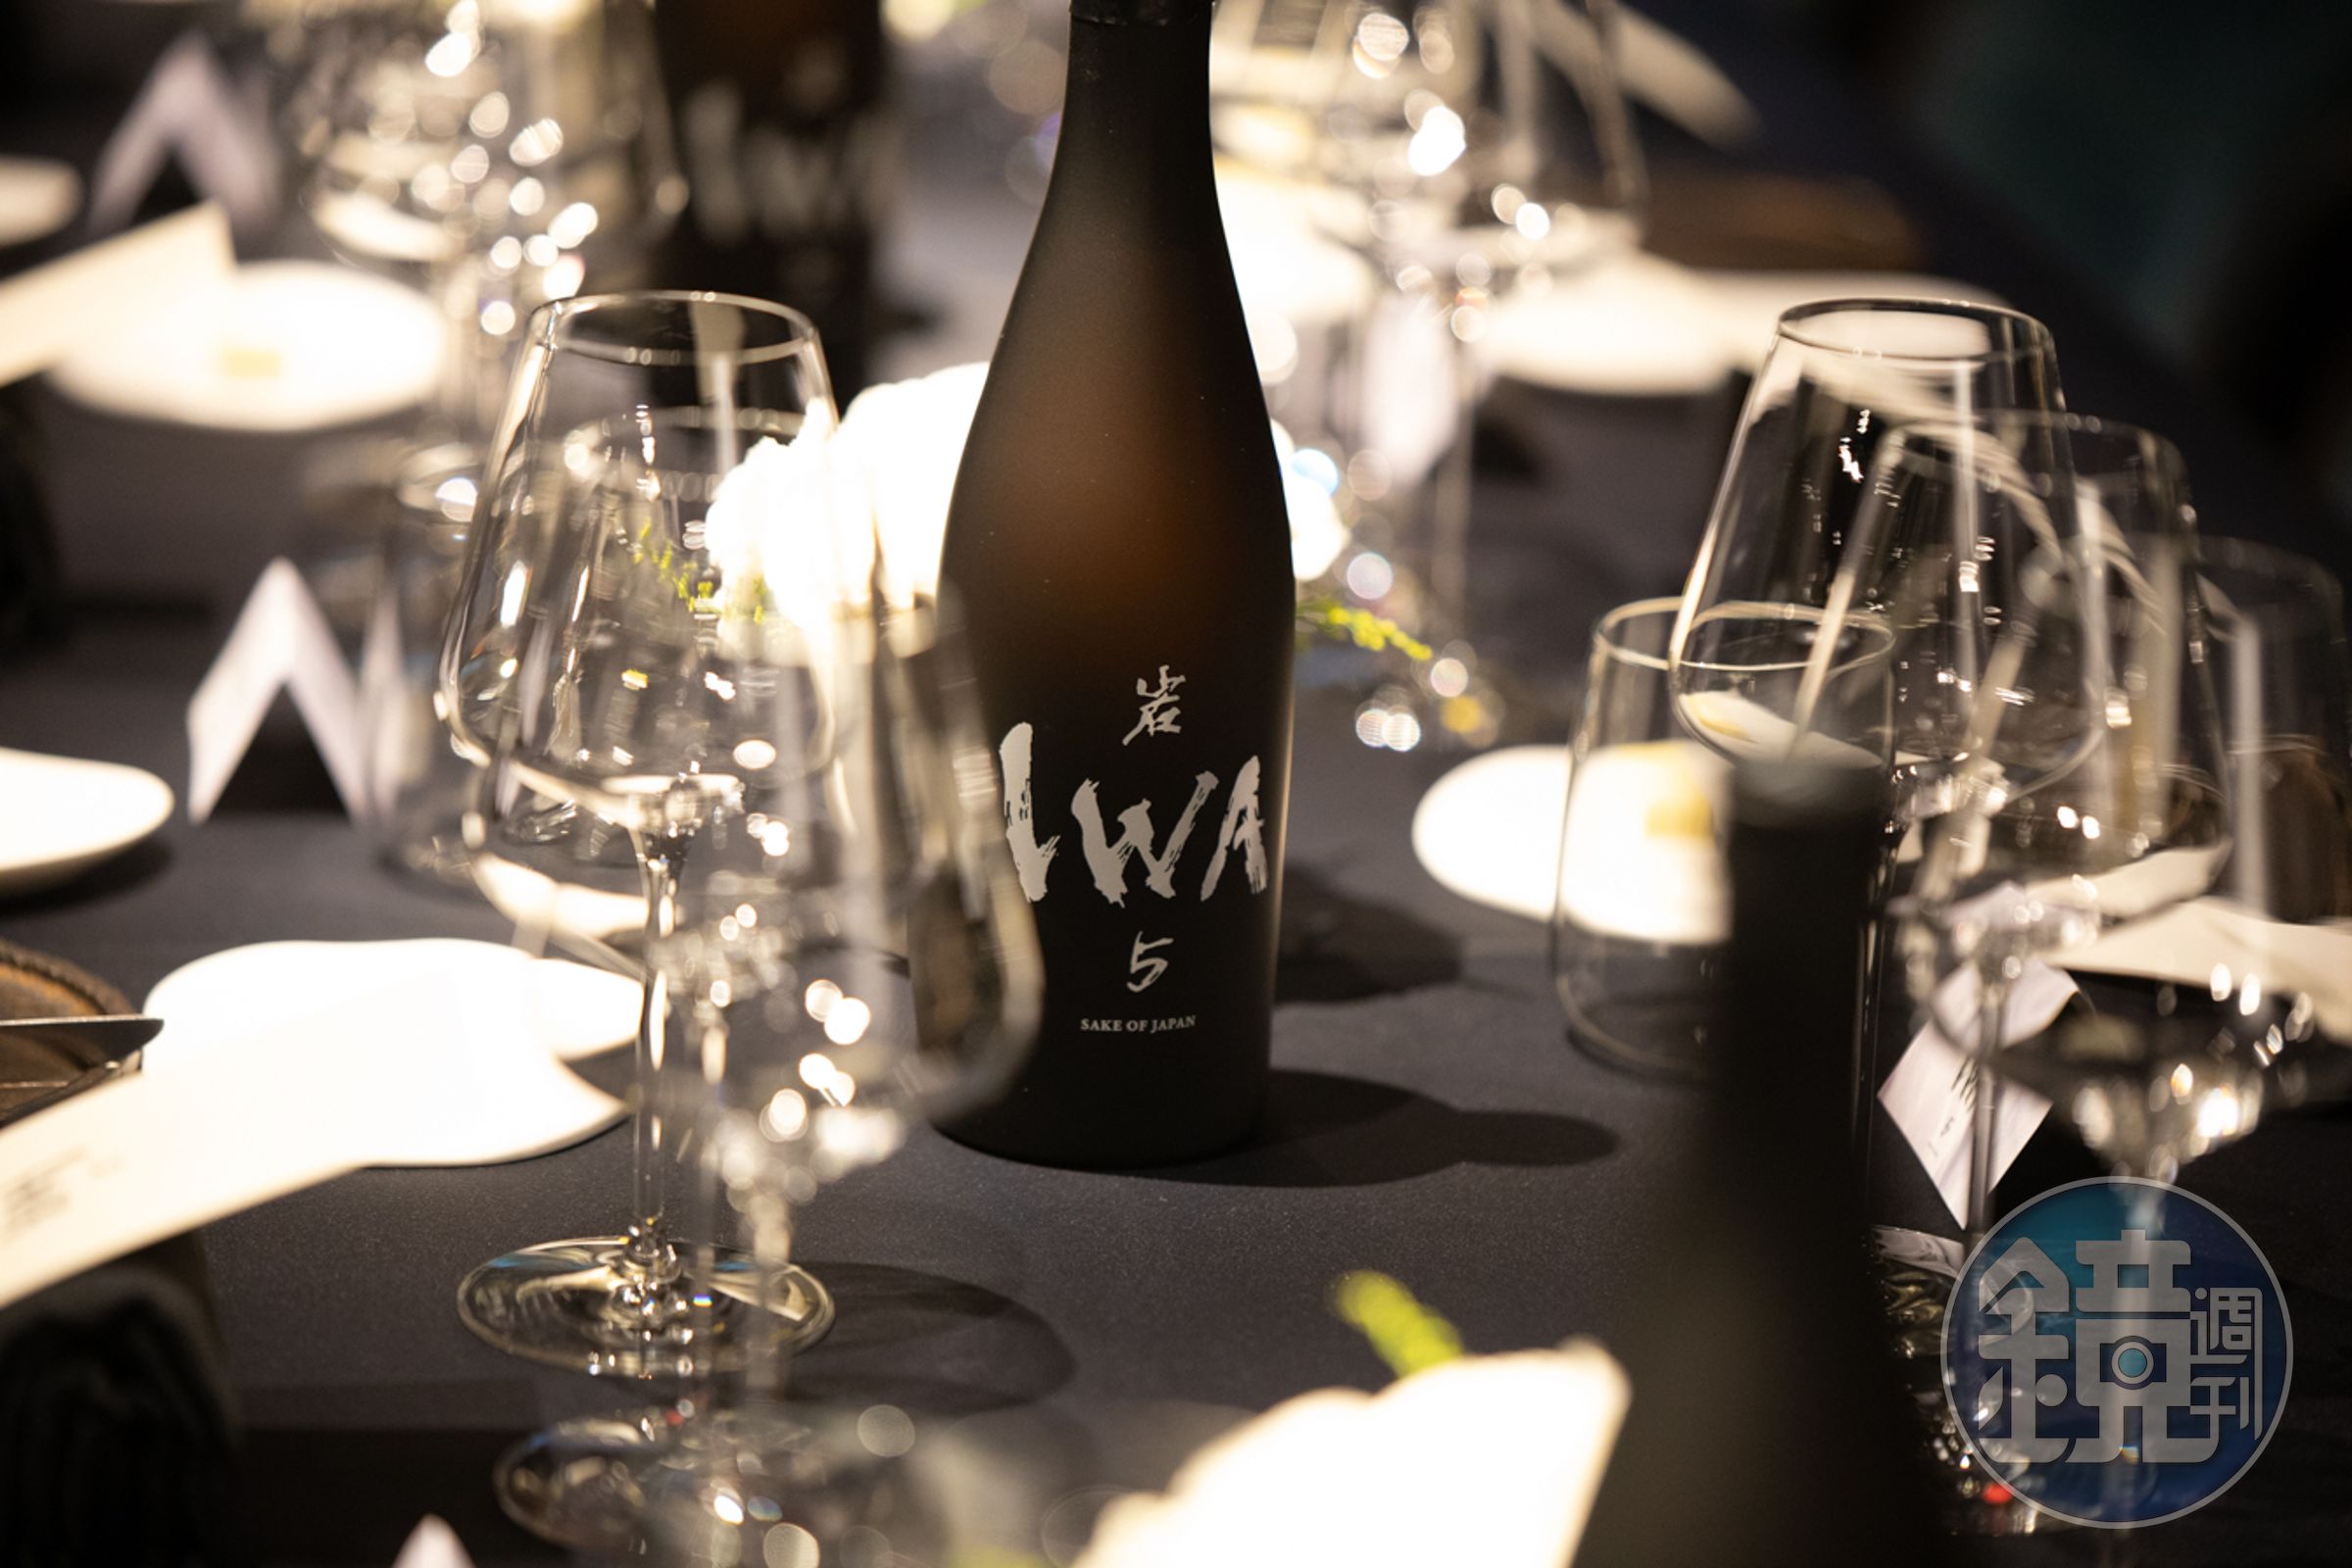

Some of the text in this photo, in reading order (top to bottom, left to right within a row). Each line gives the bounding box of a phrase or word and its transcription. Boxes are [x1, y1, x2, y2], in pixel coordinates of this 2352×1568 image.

[1122, 664, 1186, 746] 岩
[1127, 931, 1174, 993] 5
[1080, 1014, 1196, 1034] SAKE OF JAPAN
